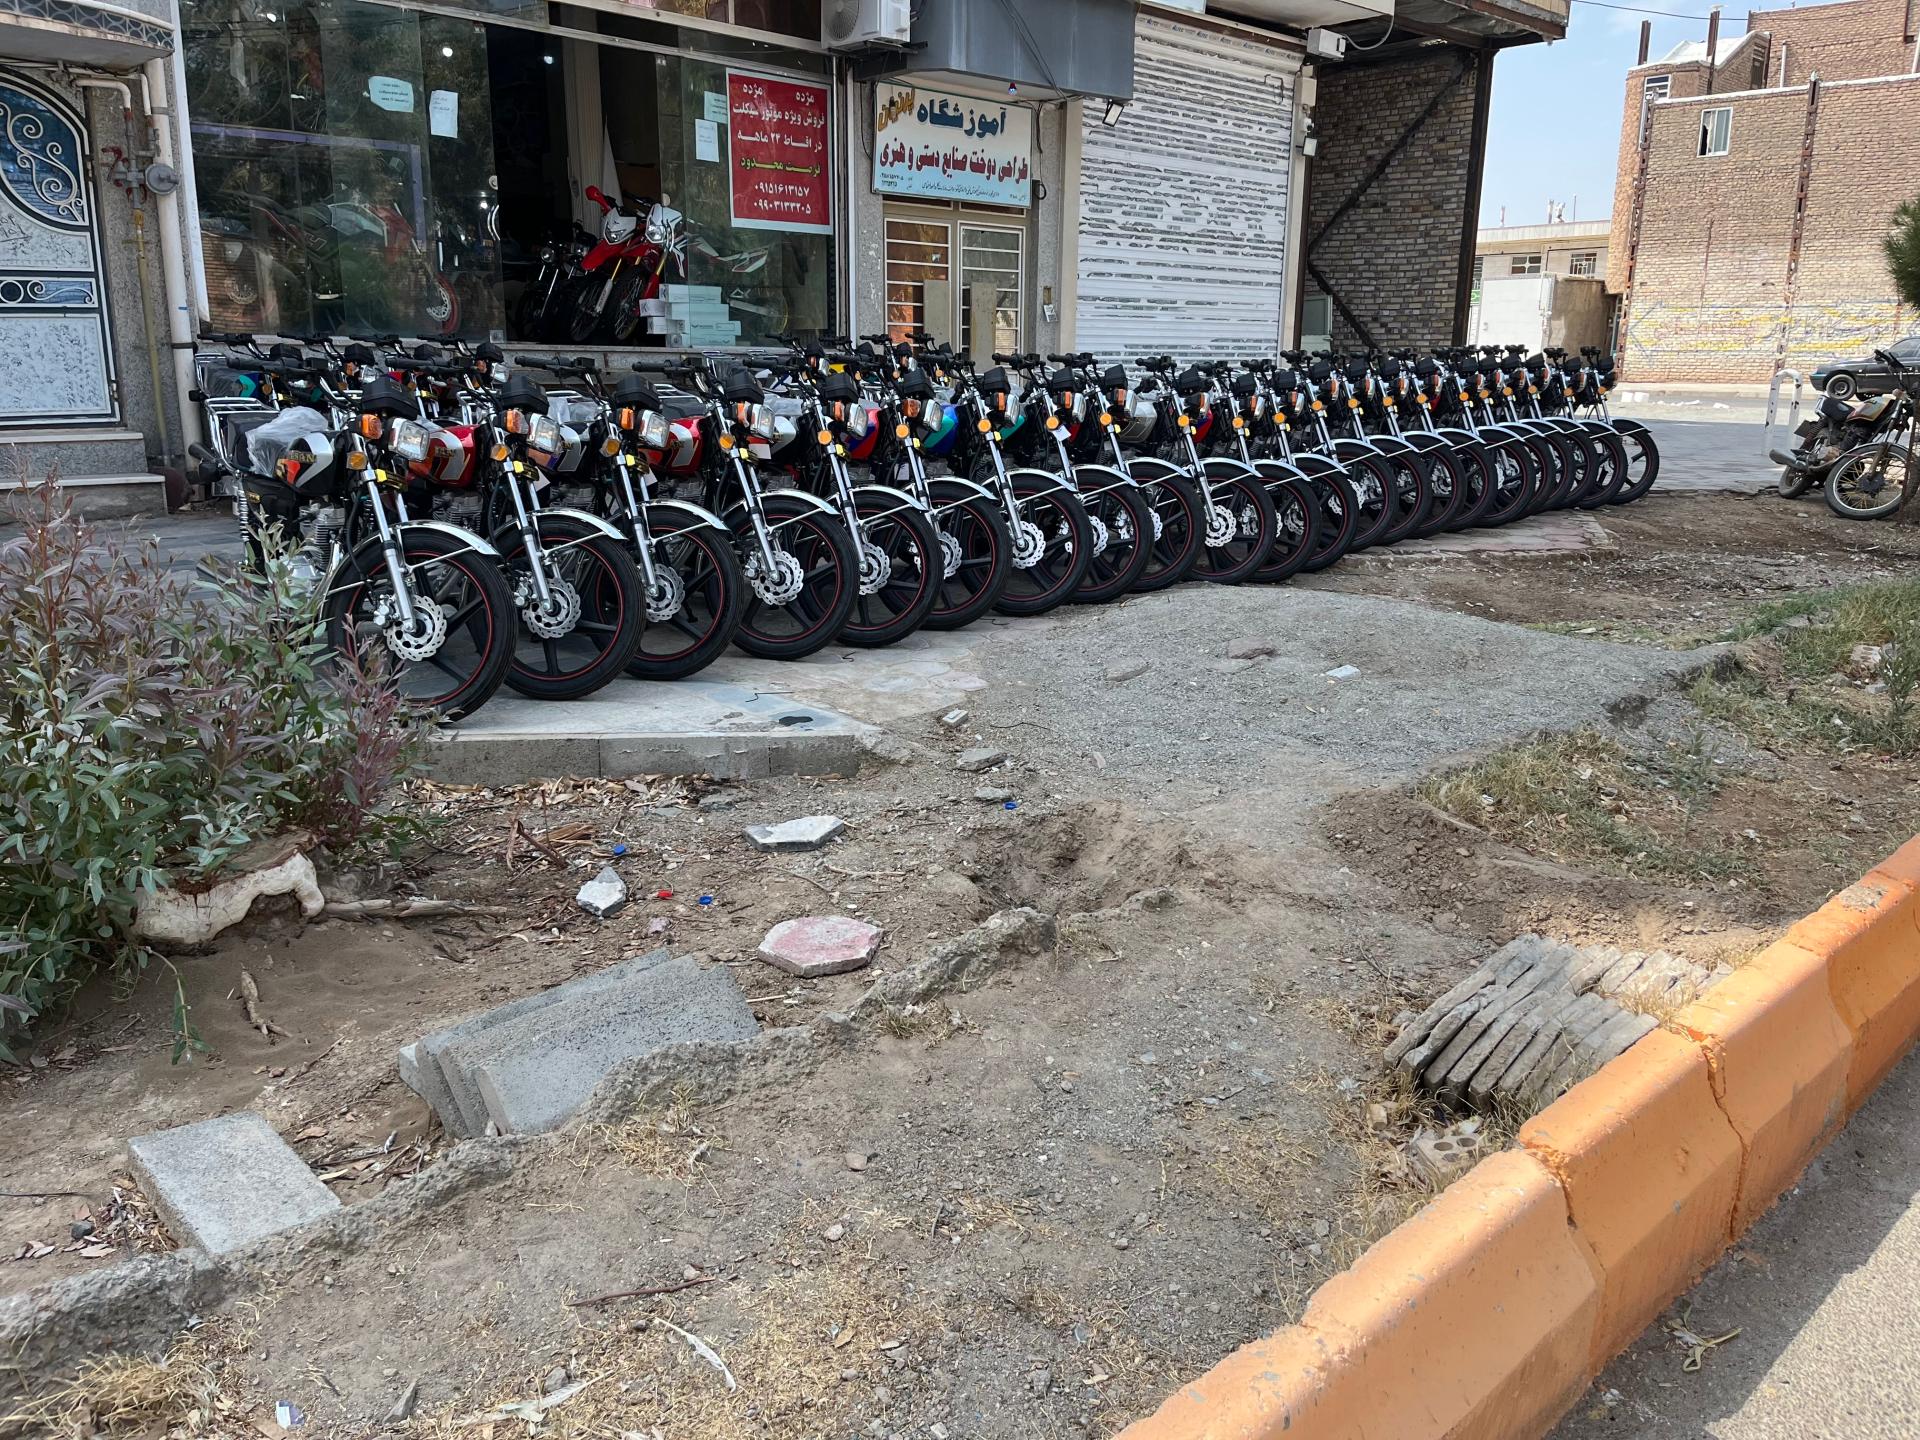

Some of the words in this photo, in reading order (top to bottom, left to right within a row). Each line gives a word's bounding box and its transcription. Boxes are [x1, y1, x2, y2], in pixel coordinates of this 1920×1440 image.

[743, 83, 763, 98] مژده
[795, 91, 815, 105] مژده
[732, 101, 759, 118] سیکلت
[761, 106, 783, 122] موتور
[784, 110, 802, 126] ویژه
[916, 98, 1008, 138] آموزشگاه
[802, 111, 826, 129] فروش
[737, 129, 769, 143] ماهه
[814, 140, 823, 153] در
[879, 137, 906, 168] هنری
[740, 156, 784, 171] محدود
[907, 146, 914, 171] و
[915, 144, 941, 172] دستی
[941, 145, 968, 178] صنایع
[969, 148, 997, 181] دوخت
[785, 160, 821, 177] فرصت
[997, 155, 1029, 185] طراحی
